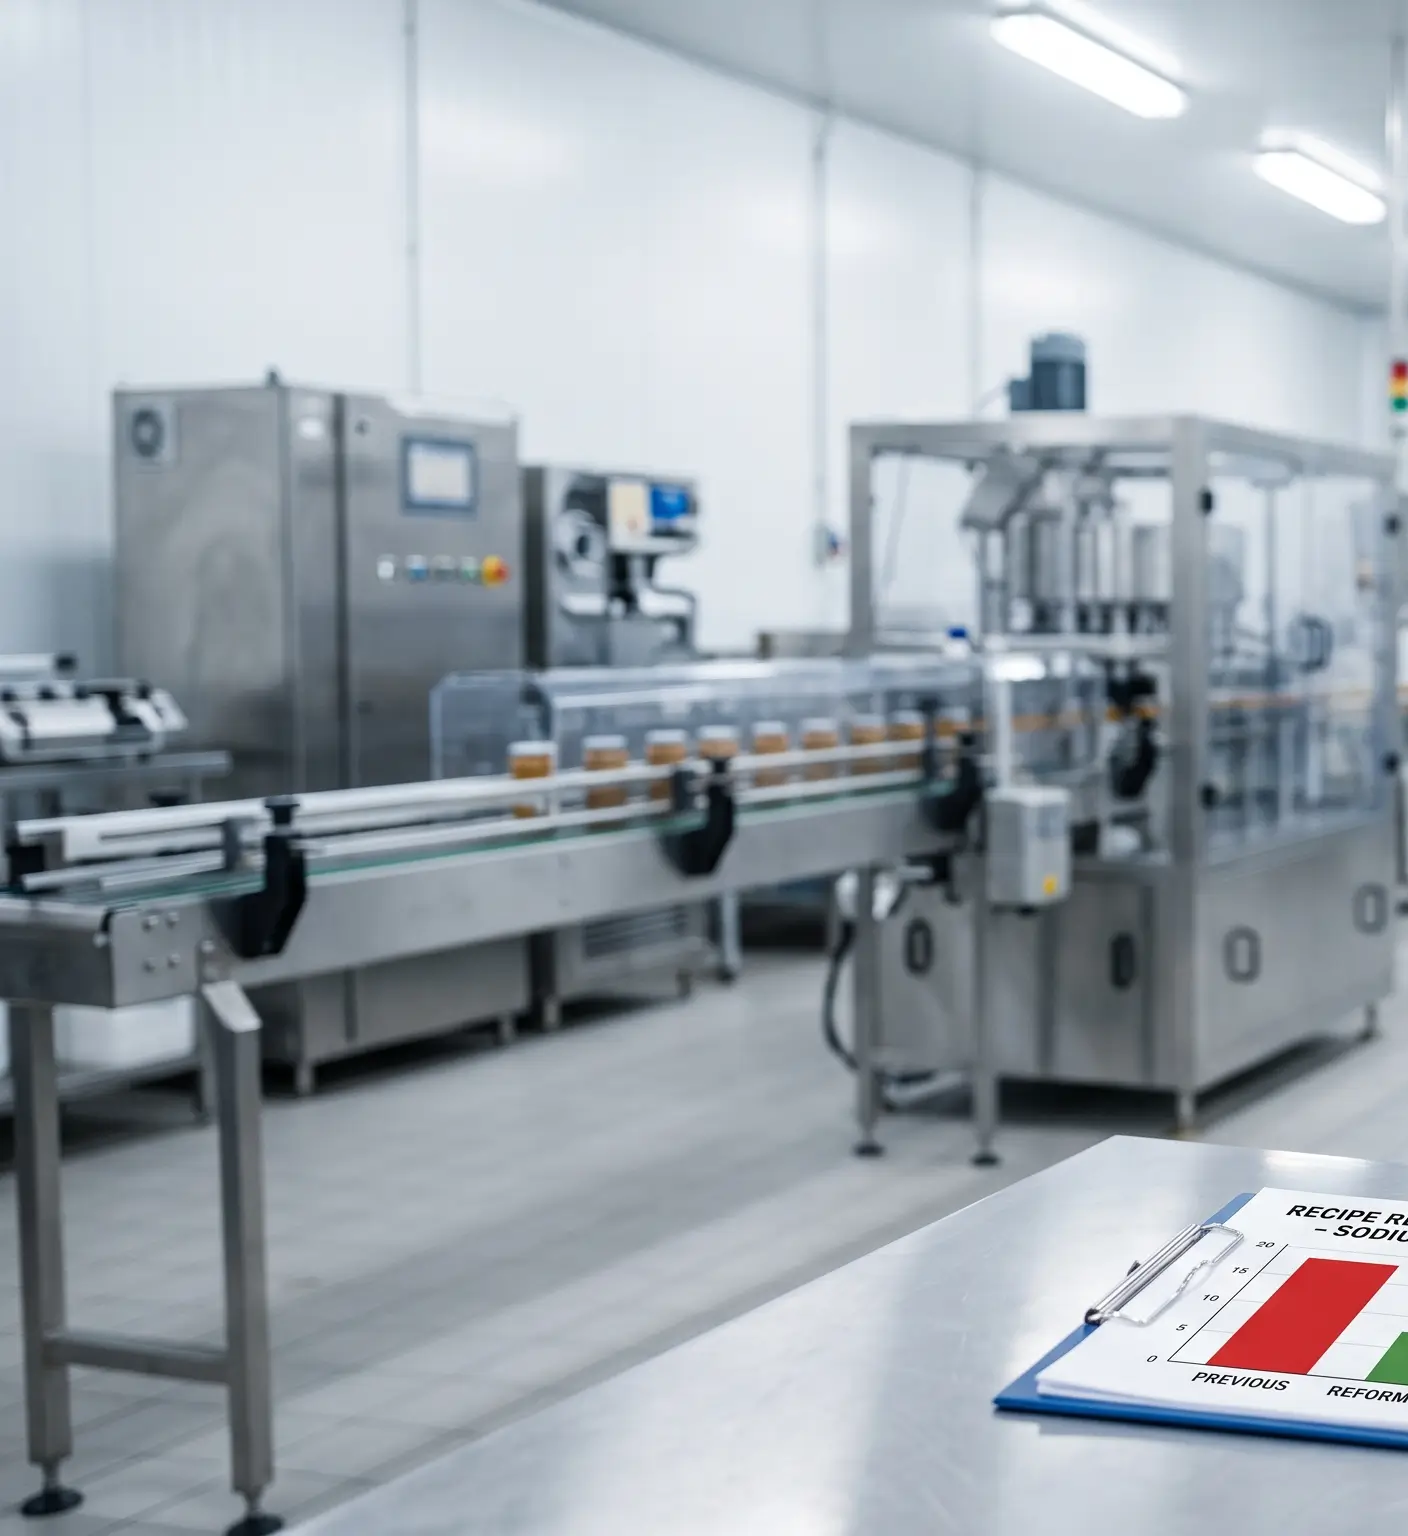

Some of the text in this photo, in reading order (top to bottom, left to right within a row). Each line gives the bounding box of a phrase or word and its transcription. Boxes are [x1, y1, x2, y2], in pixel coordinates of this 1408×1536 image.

[1286, 1204, 1382, 1223] RECIPE
[1232, 1266, 1249, 1274] 15
[1202, 1294, 1220, 1302] 10
[1176, 1323, 1188, 1331] 5
[1146, 1355, 1158, 1363] 0
[1191, 1371, 1290, 1391] PREVIOUS
